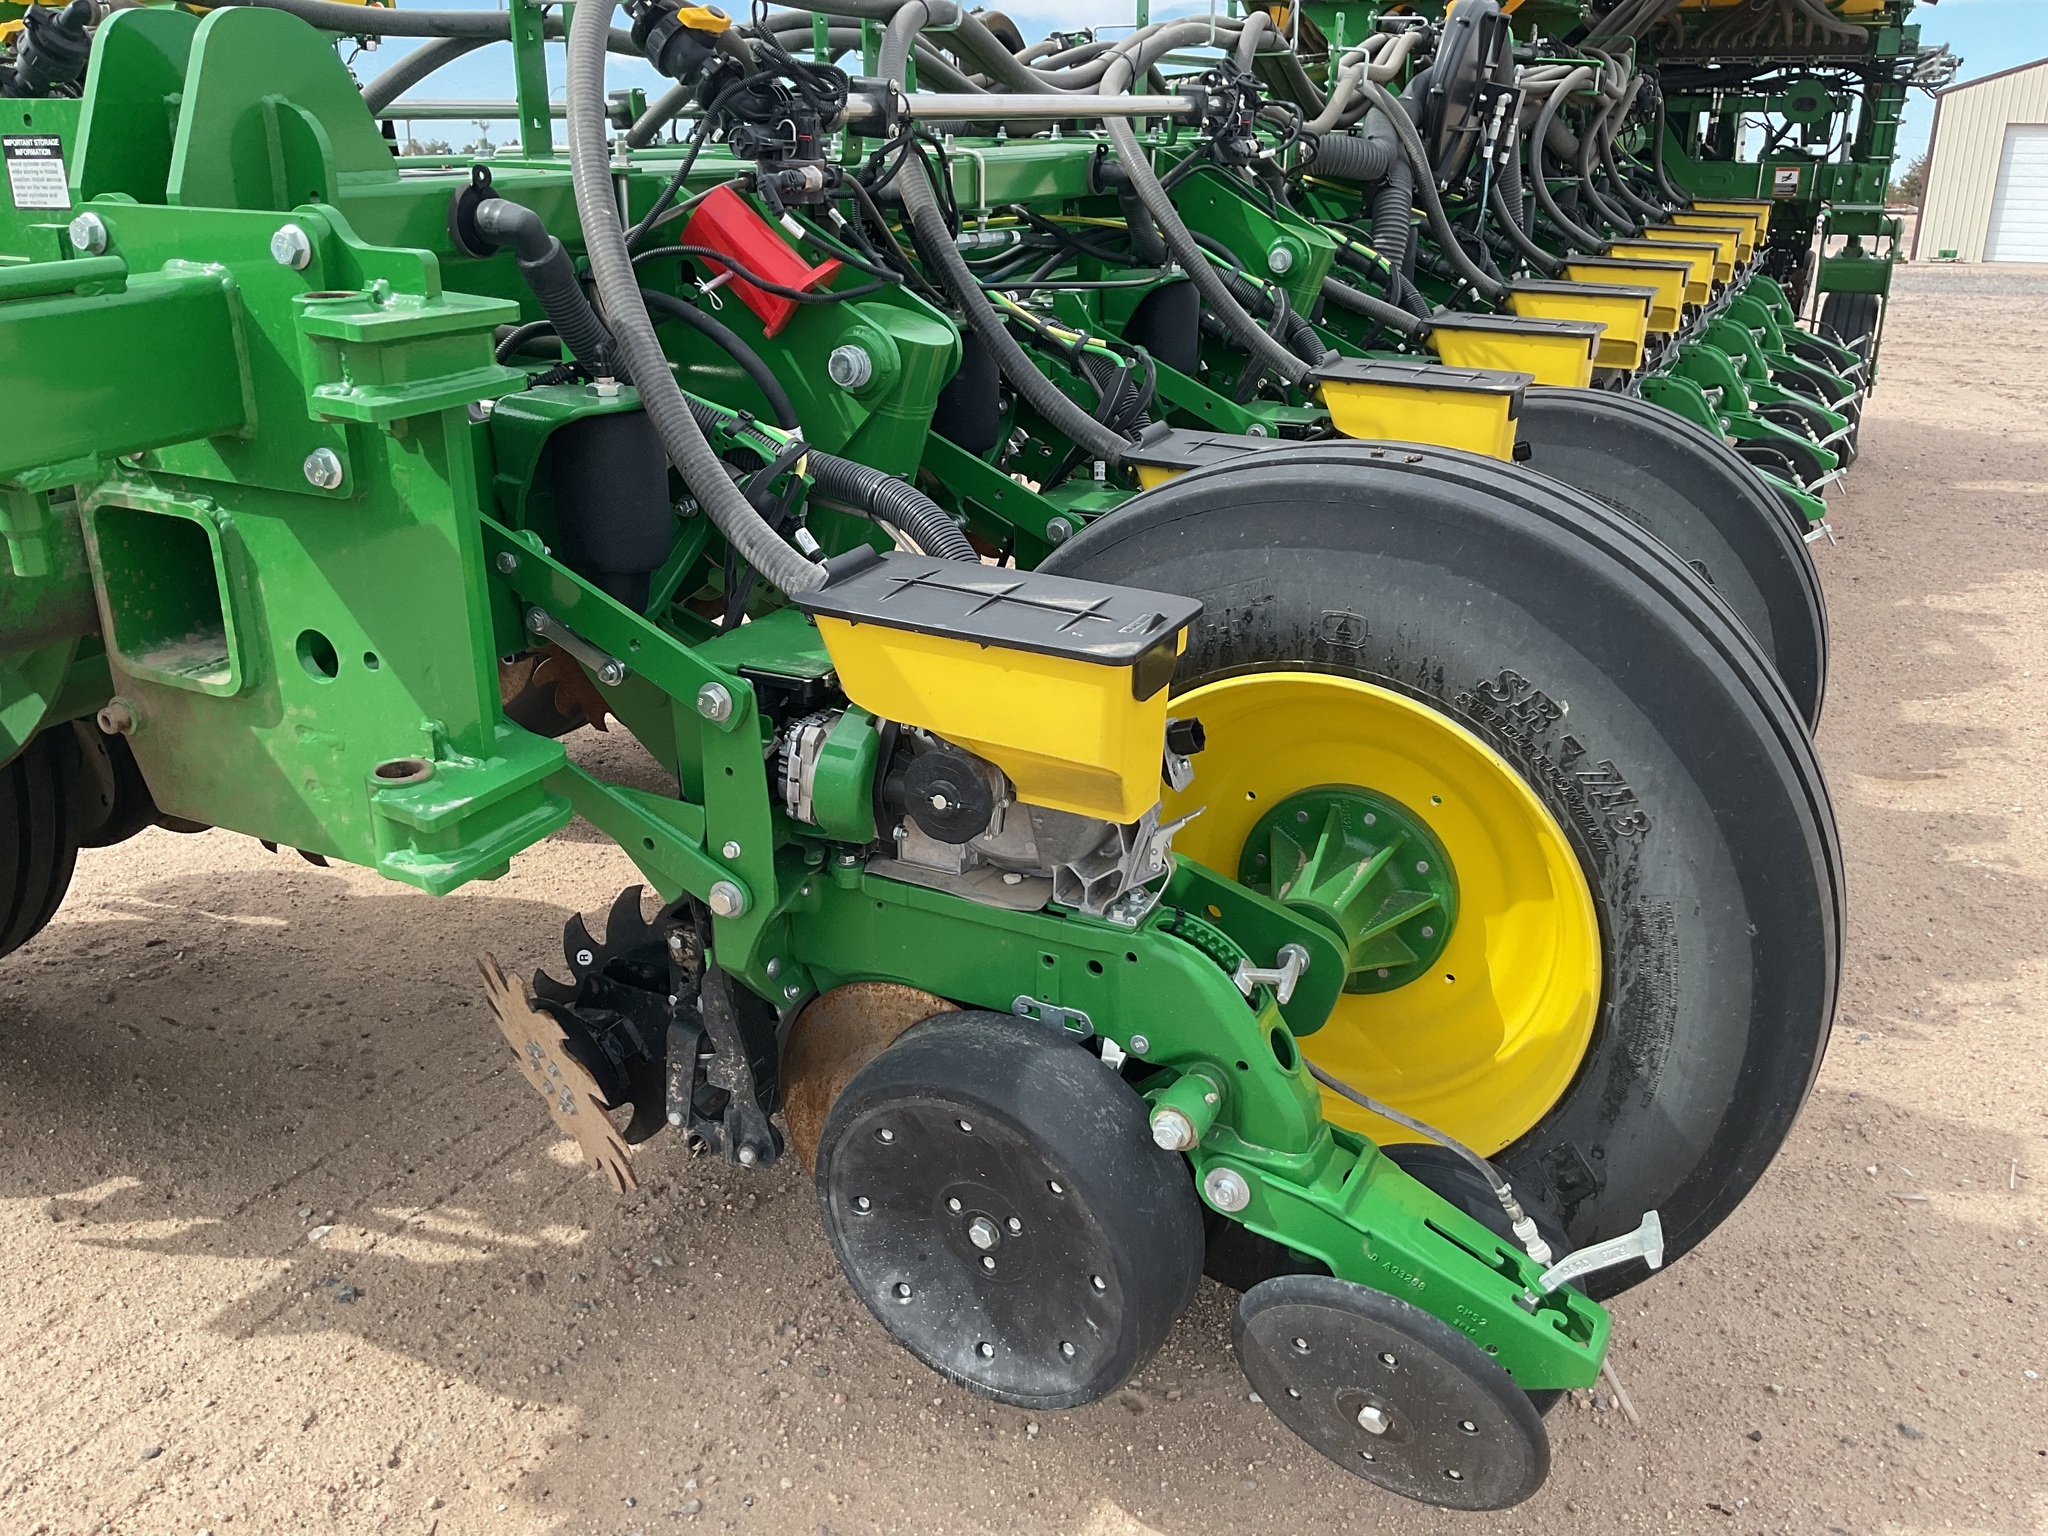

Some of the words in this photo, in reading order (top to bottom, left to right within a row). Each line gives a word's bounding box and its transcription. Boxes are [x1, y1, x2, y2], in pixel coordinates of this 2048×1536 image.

[1454, 691, 1538, 756] STUBBLE
[1533, 754, 1613, 855] RESISTANT
[1477, 668, 1564, 733] SR
[1576, 758, 1652, 837] 713
[579, 953, 589, 962] R
